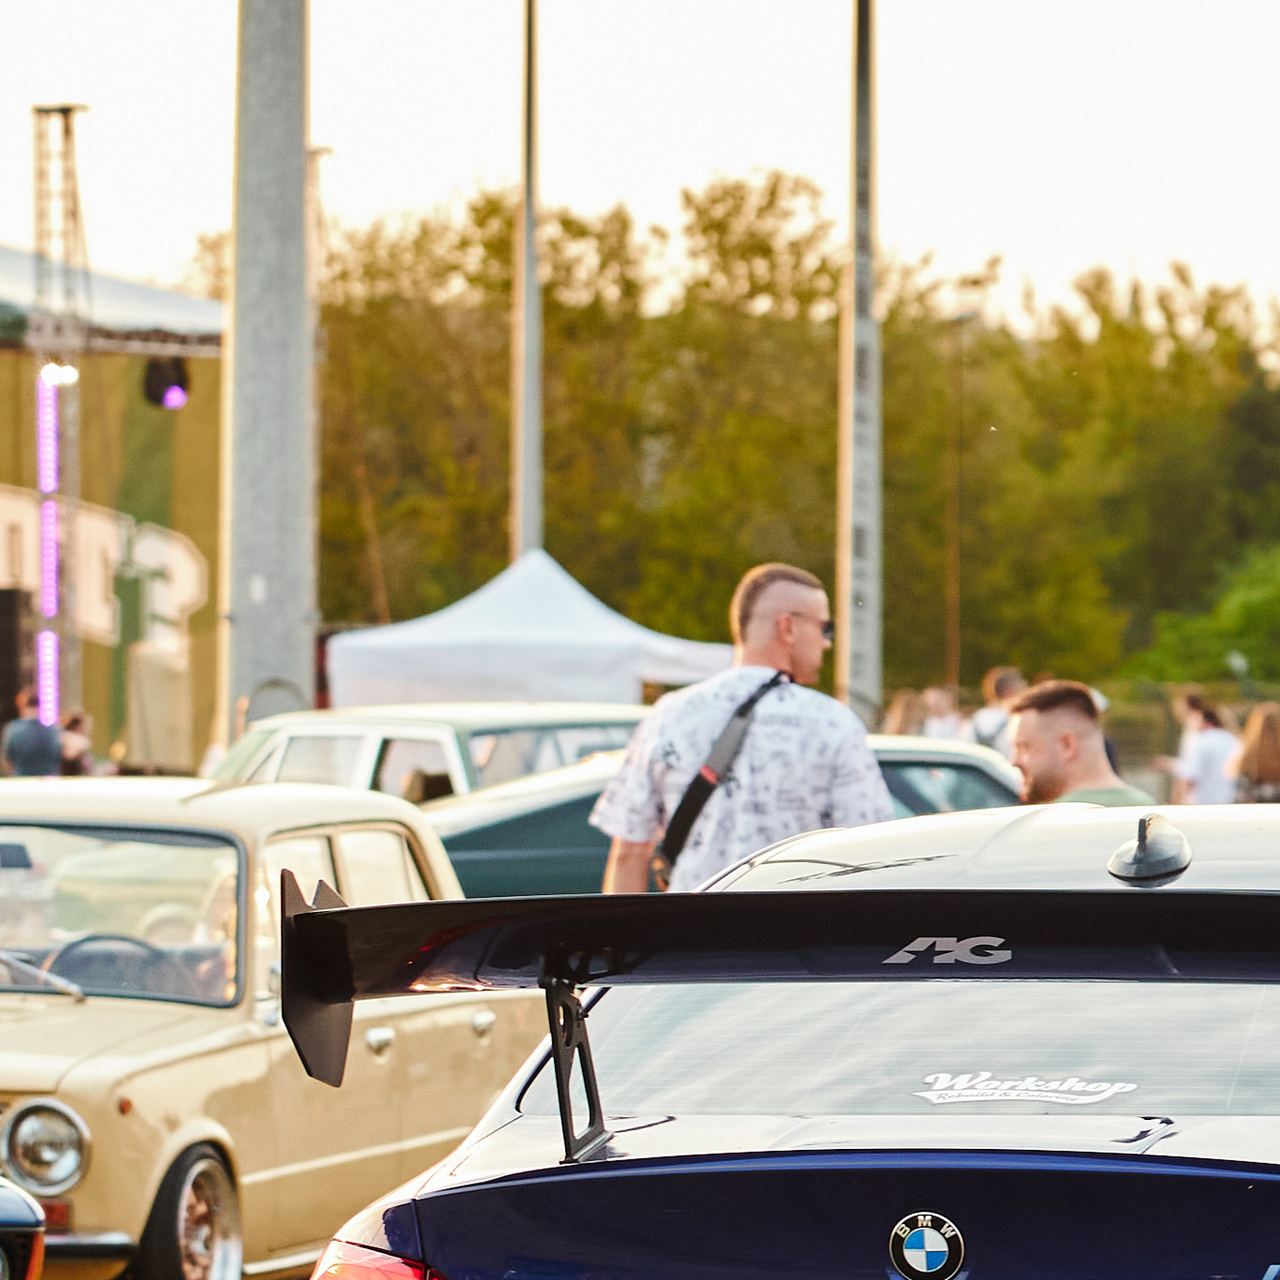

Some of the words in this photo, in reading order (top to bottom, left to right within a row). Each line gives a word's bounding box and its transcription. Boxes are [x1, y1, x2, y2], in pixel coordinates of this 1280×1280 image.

[923, 1071, 1138, 1093] Workshop
[936, 1090, 994, 1101] Rebuild
[896, 1215, 956, 1239] BMW
